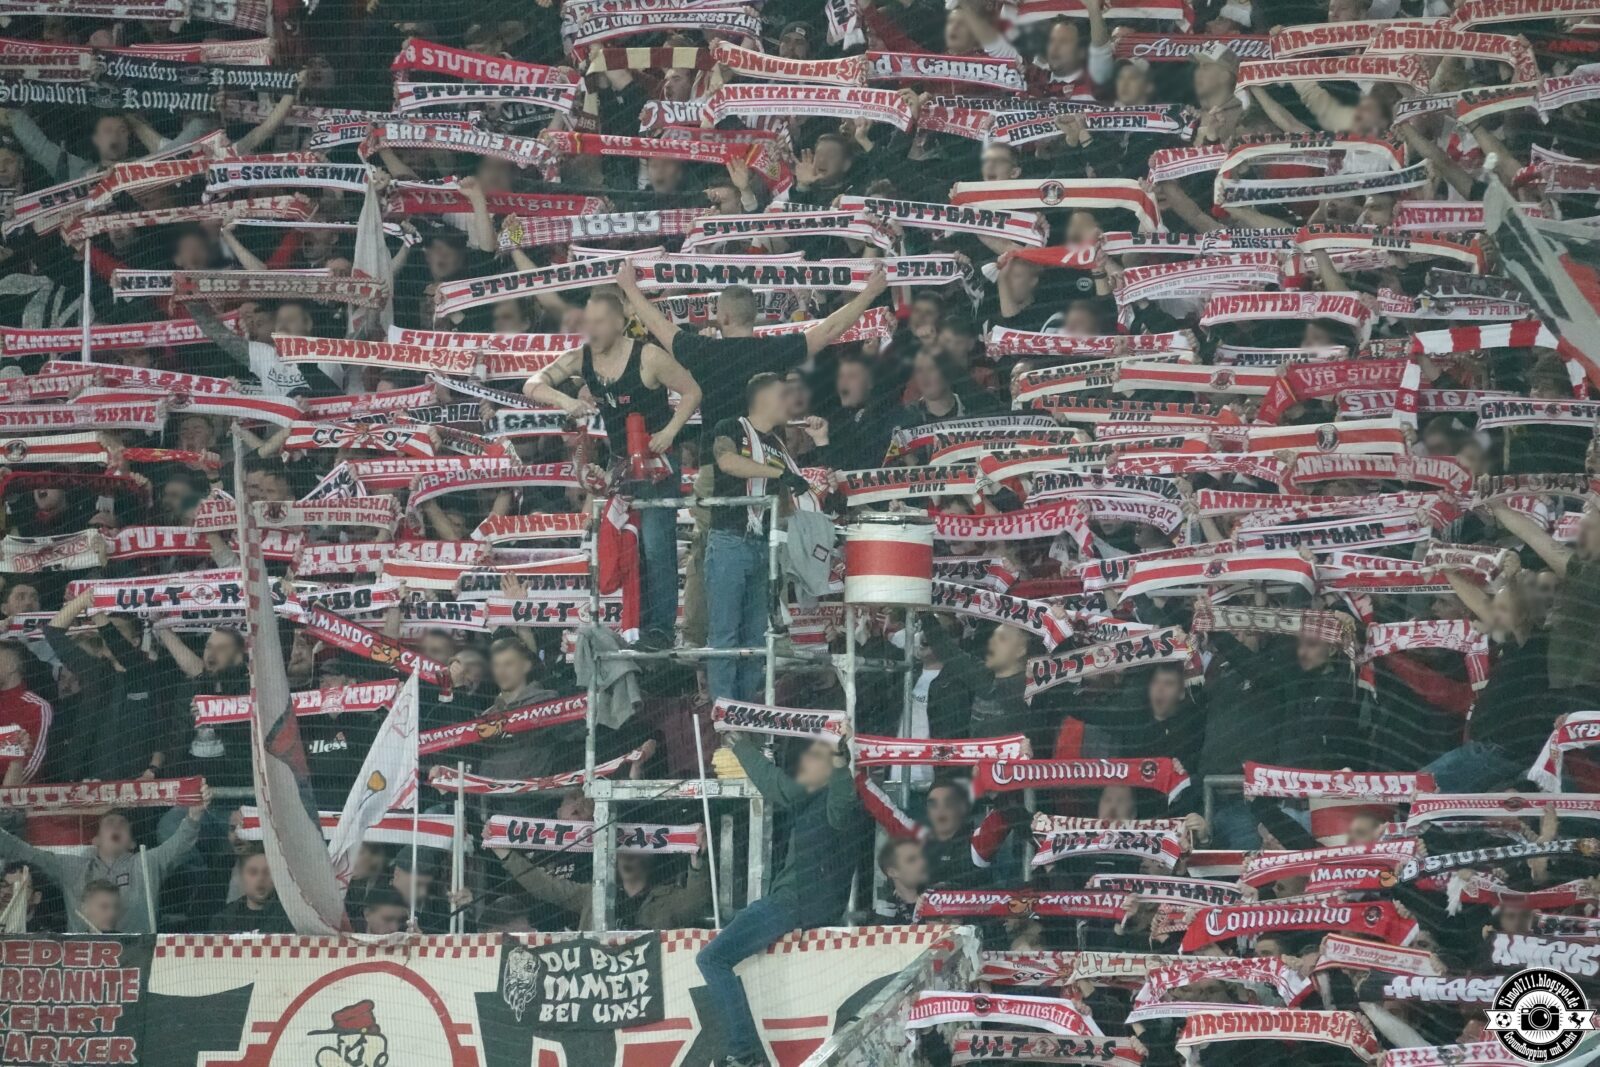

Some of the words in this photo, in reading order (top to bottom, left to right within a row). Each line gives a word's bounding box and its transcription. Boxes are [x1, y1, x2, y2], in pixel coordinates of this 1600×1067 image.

[611, 15, 642, 34] UND
[1404, 28, 1454, 50] SIND
[1462, 32, 1505, 53] DER
[96, 54, 178, 82] Schwaben
[422, 47, 545, 84] STUTTGART
[1284, 58, 1337, 75] SIND
[1345, 56, 1391, 75] DER
[413, 85, 569, 101] STUTTGART
[386, 124, 427, 140] BAD
[601, 134, 633, 146] VfB
[640, 136, 726, 155] Stuttgart
[488, 195, 576, 212] tuttgart
[865, 198, 1012, 229] STUTTGART
[572, 212, 660, 237] 1893
[704, 214, 855, 236] STUTTGART
[1372, 236, 1411, 249] KURVE
[470, 258, 627, 298] STUTTGART
[654, 263, 852, 285] COMMANDO
[321, 339, 371, 359] SIND
[379, 344, 422, 364] DER
[312, 427, 344, 444] CC
[383, 428, 413, 445] 97
[489, 515, 538, 536] WIR
[1033, 629, 1176, 687] ULTRAS
[991, 758, 1129, 785] Commando
[1051, 831, 1163, 855] ULTRAS
[1424, 840, 1577, 872] STUTTGART
[1100, 879, 1244, 906] STUTTGART
[1206, 907, 1352, 936] Commando
[540, 947, 581, 972] DU
[591, 942, 651, 972] BIST
[543, 970, 651, 1001] IMMER
[539, 1002, 581, 1023] BEI
[592, 996, 652, 1024] UNS!
[1225, 1011, 1275, 1034] SIND
[1280, 1011, 1322, 1034] DER
[969, 1035, 1117, 1062] ULTRAS
